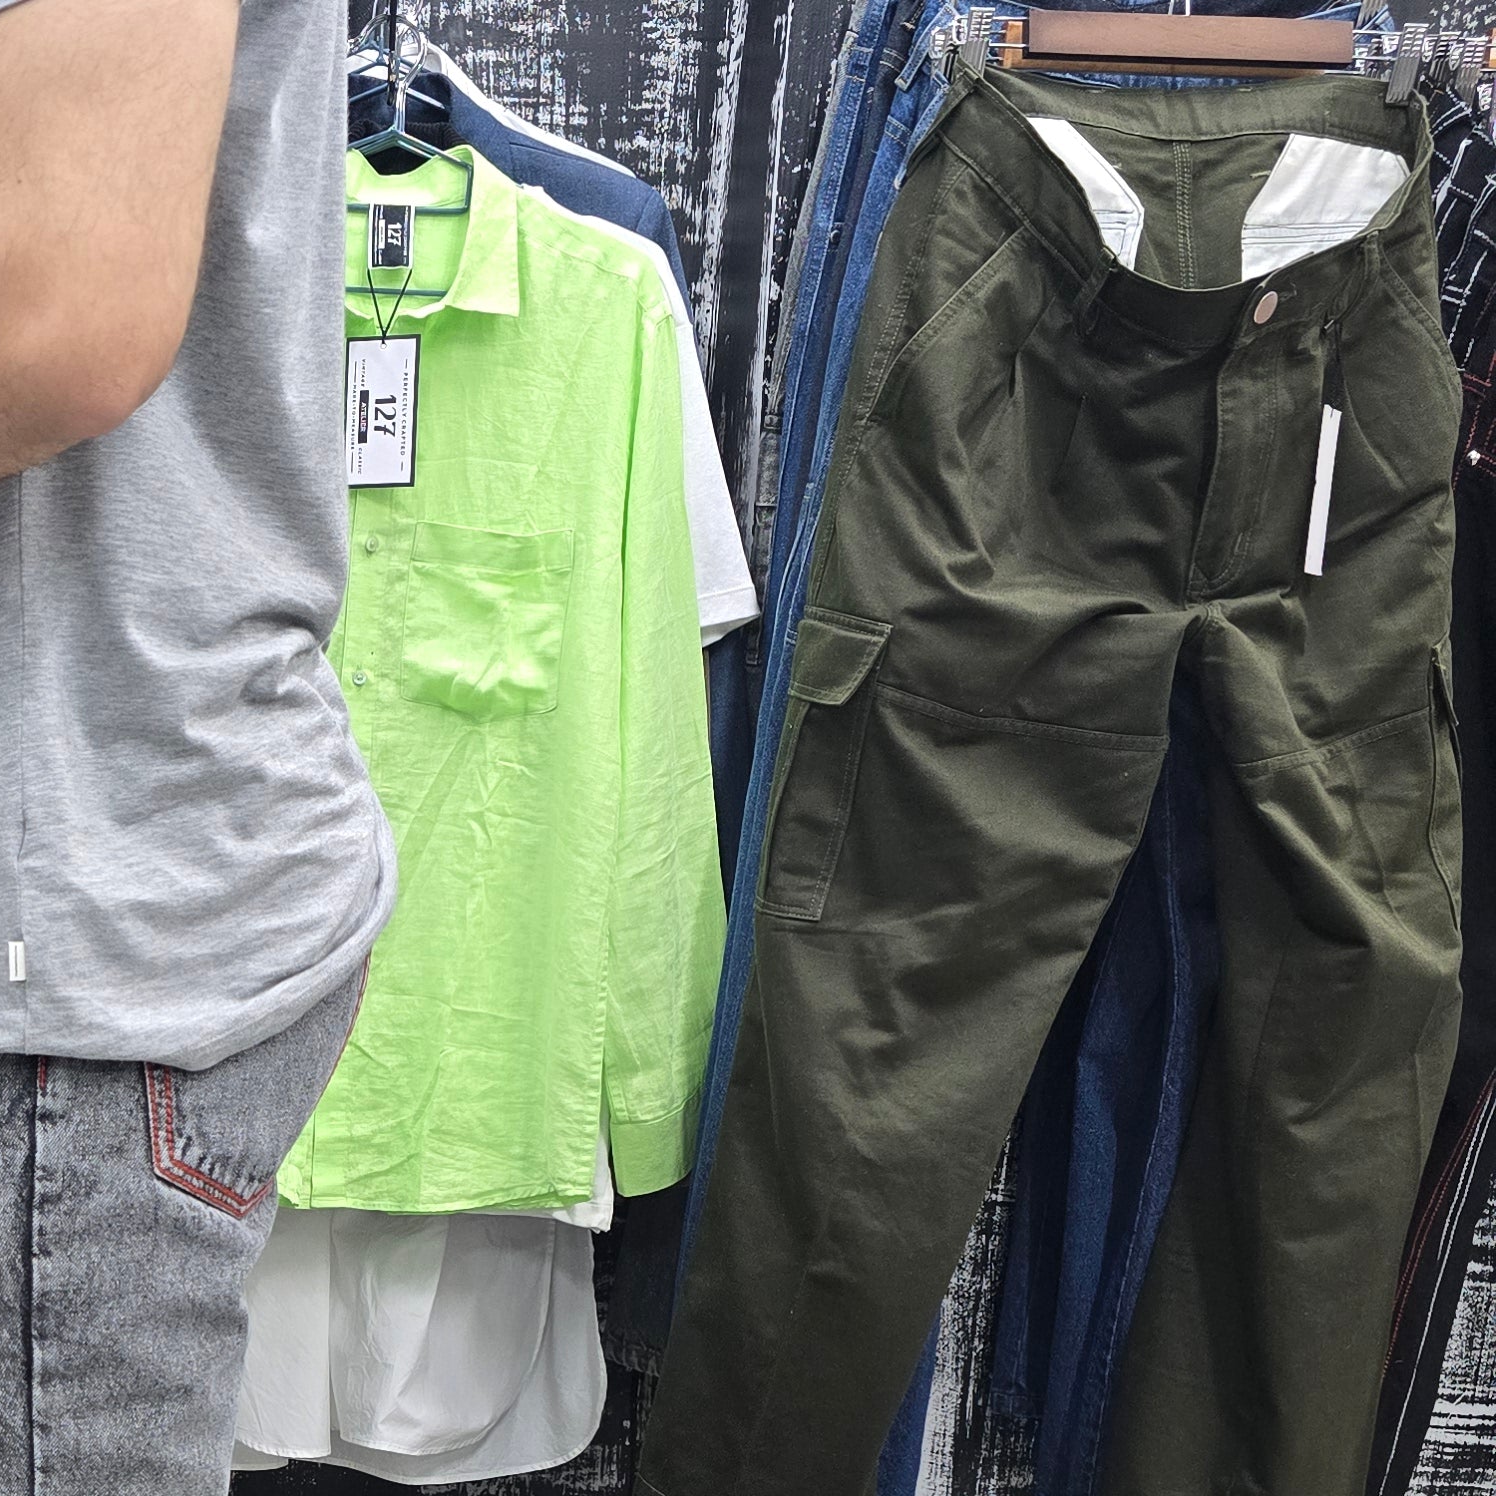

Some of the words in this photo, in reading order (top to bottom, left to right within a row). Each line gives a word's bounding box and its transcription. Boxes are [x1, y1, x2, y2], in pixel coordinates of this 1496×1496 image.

[387, 222, 402, 247] 127
[401, 372, 409, 418] PERFECTLY
[359, 401, 368, 433] ATELIER
[373, 394, 397, 438] 127
[399, 419, 407, 456] CRAFTED
